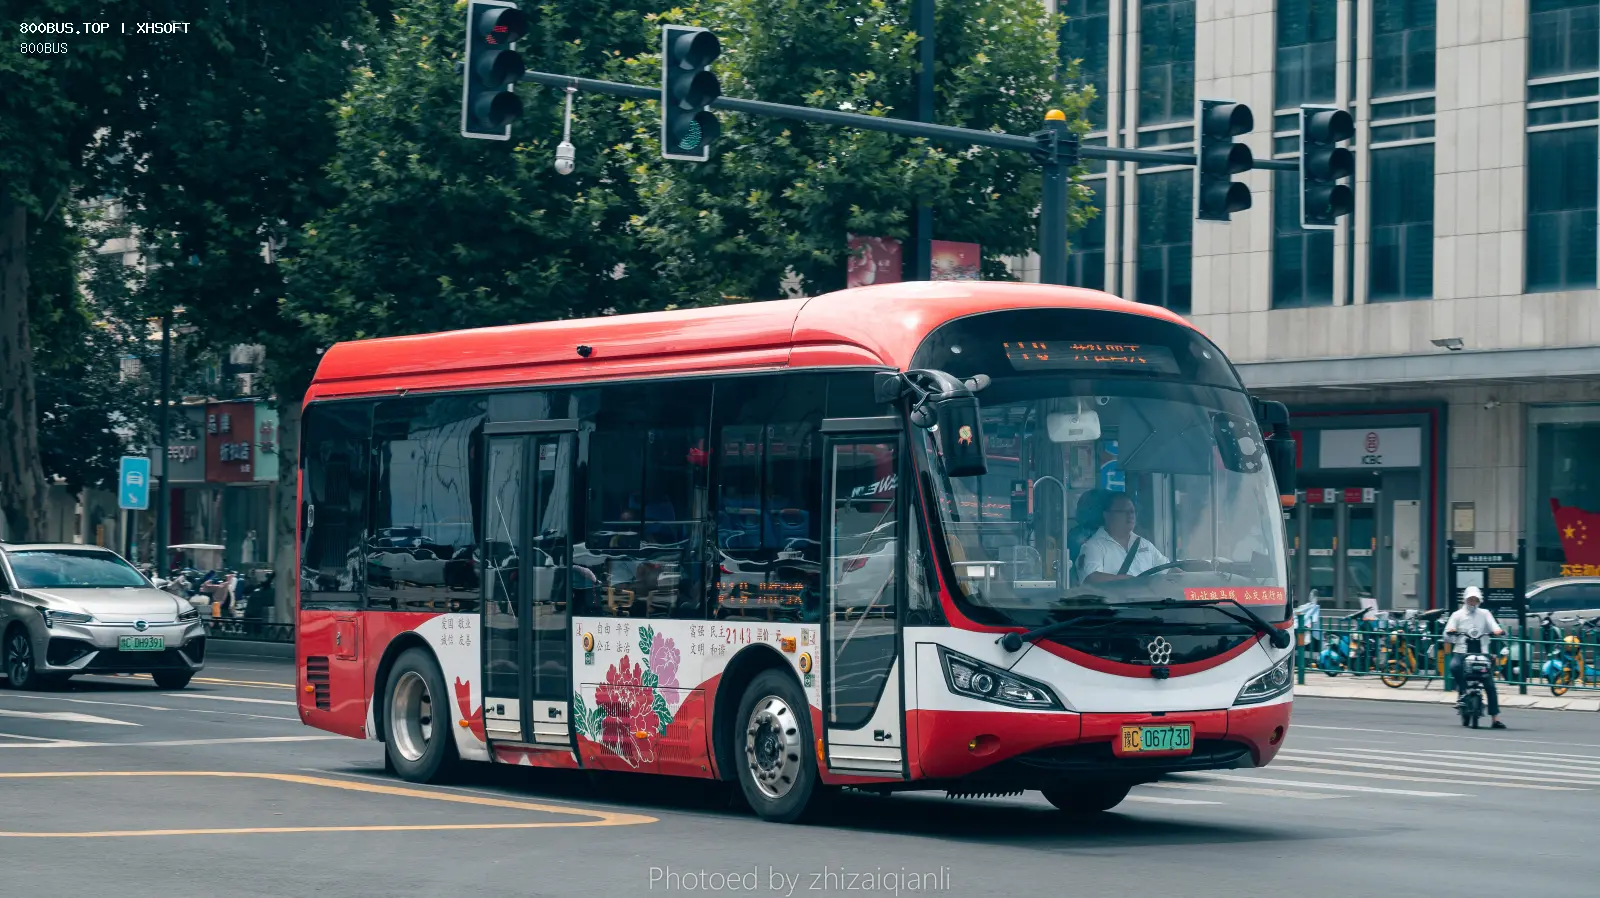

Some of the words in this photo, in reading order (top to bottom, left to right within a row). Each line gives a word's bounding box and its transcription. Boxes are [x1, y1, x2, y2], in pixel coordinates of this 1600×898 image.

[1360, 455, 1383, 465] ICBC
[597, 622, 611, 635] 自由
[615, 622, 631, 636] 平等
[710, 625, 726, 639] 民主
[725, 627, 752, 644] 2143
[596, 640, 611, 652] 公正
[689, 642, 705, 656] 文明
[710, 642, 726, 657] 和谐
[1145, 728, 1190, 748] 06773D
